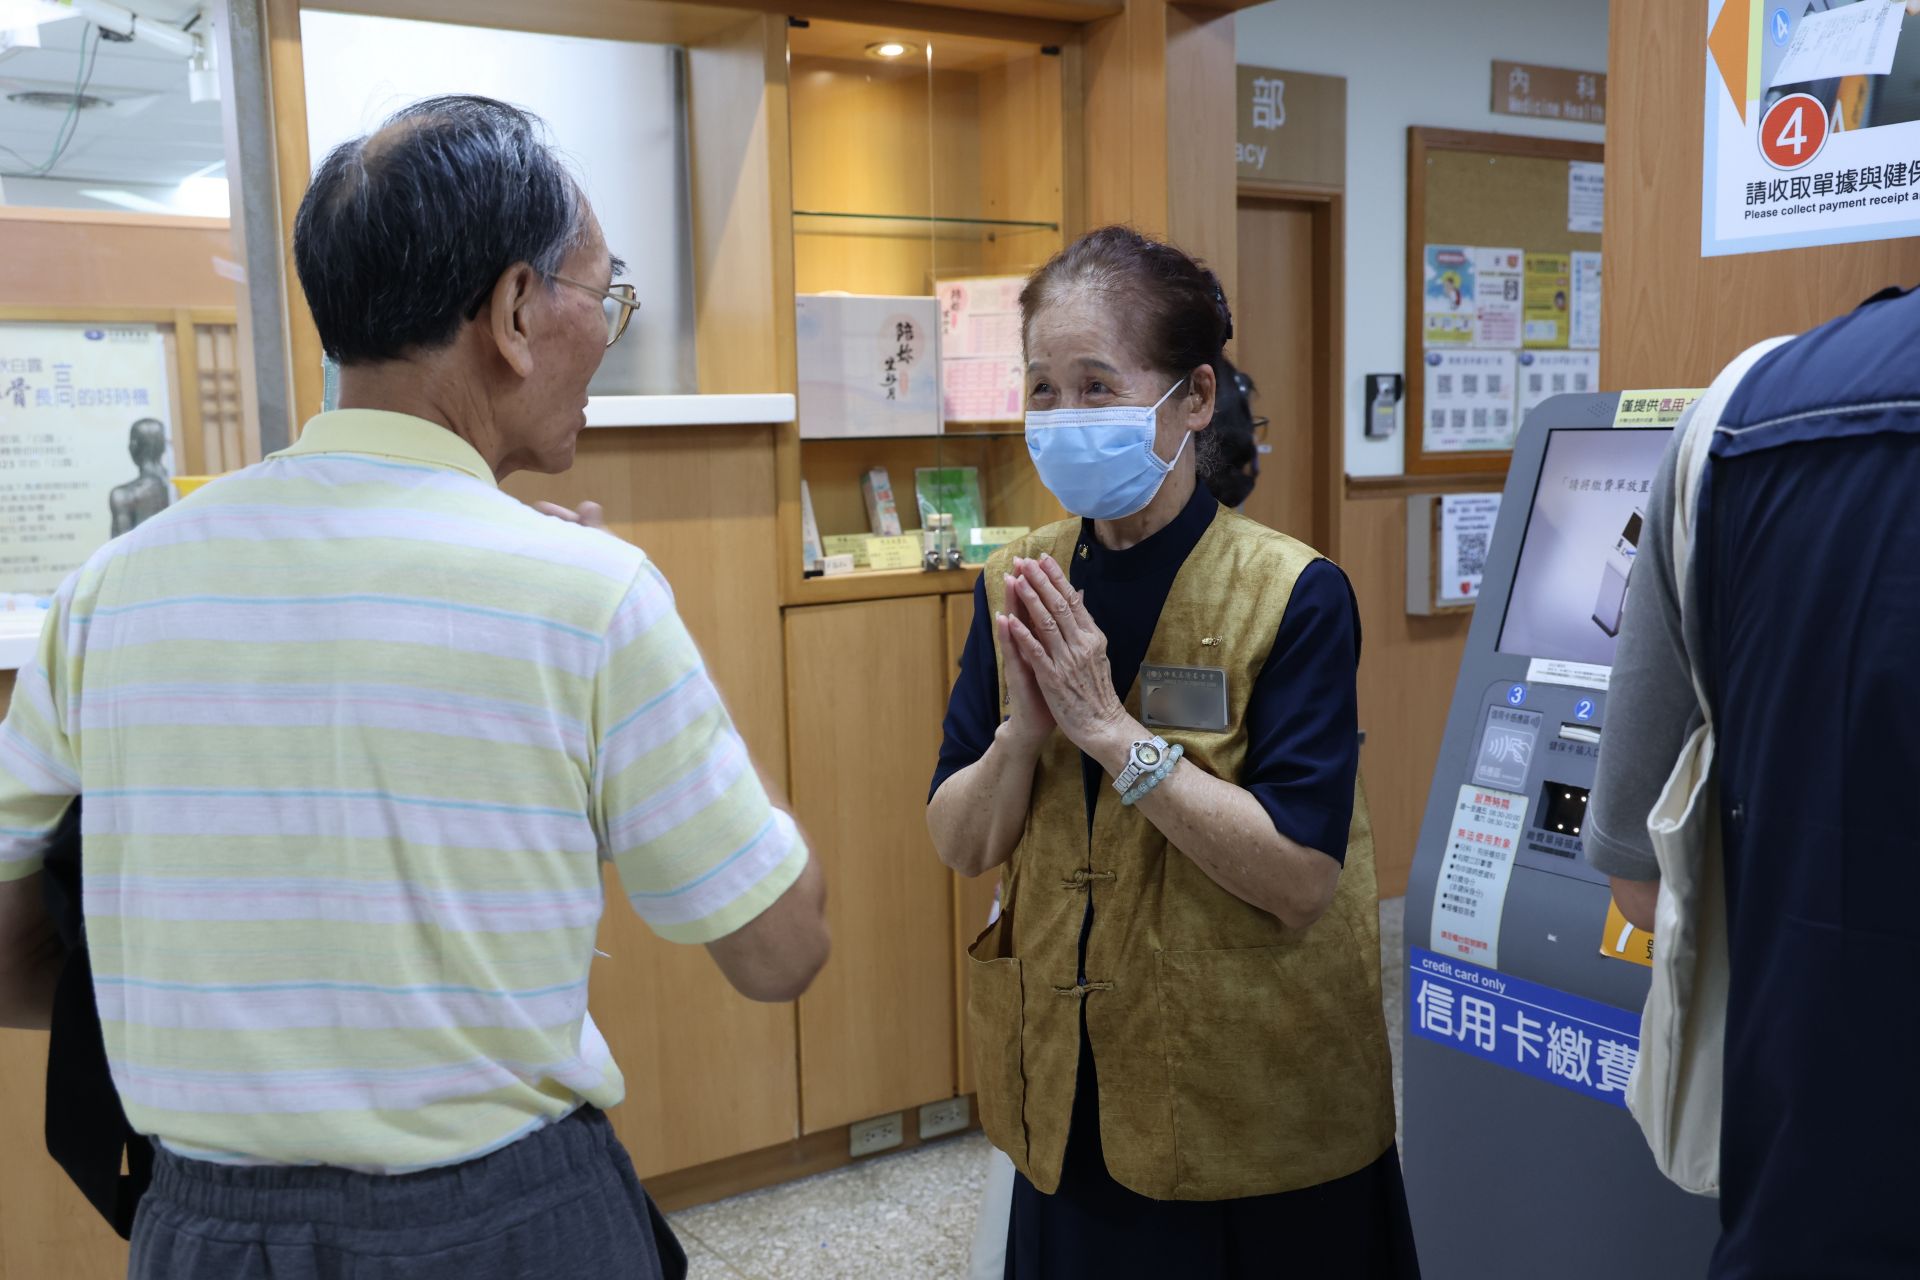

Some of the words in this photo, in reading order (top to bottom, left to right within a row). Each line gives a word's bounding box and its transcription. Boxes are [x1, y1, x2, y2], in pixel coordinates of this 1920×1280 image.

[1252, 76, 1286, 130] 部
[1776, 107, 1807, 155] 4
[1744, 209, 1778, 220] Please
[1781, 202, 1816, 216] collect
[1819, 196, 1866, 213] payment
[1869, 192, 1909, 206] receipt
[1561, 476, 1653, 493] 「請將繳費單放置
[1510, 686, 1523, 703] 3
[1577, 700, 1591, 718] 2
[1422, 957, 1452, 976] credit
[1455, 967, 1479, 985] card
[1481, 976, 1506, 994] only
[1417, 980, 1640, 1092] 信用卡繳費
